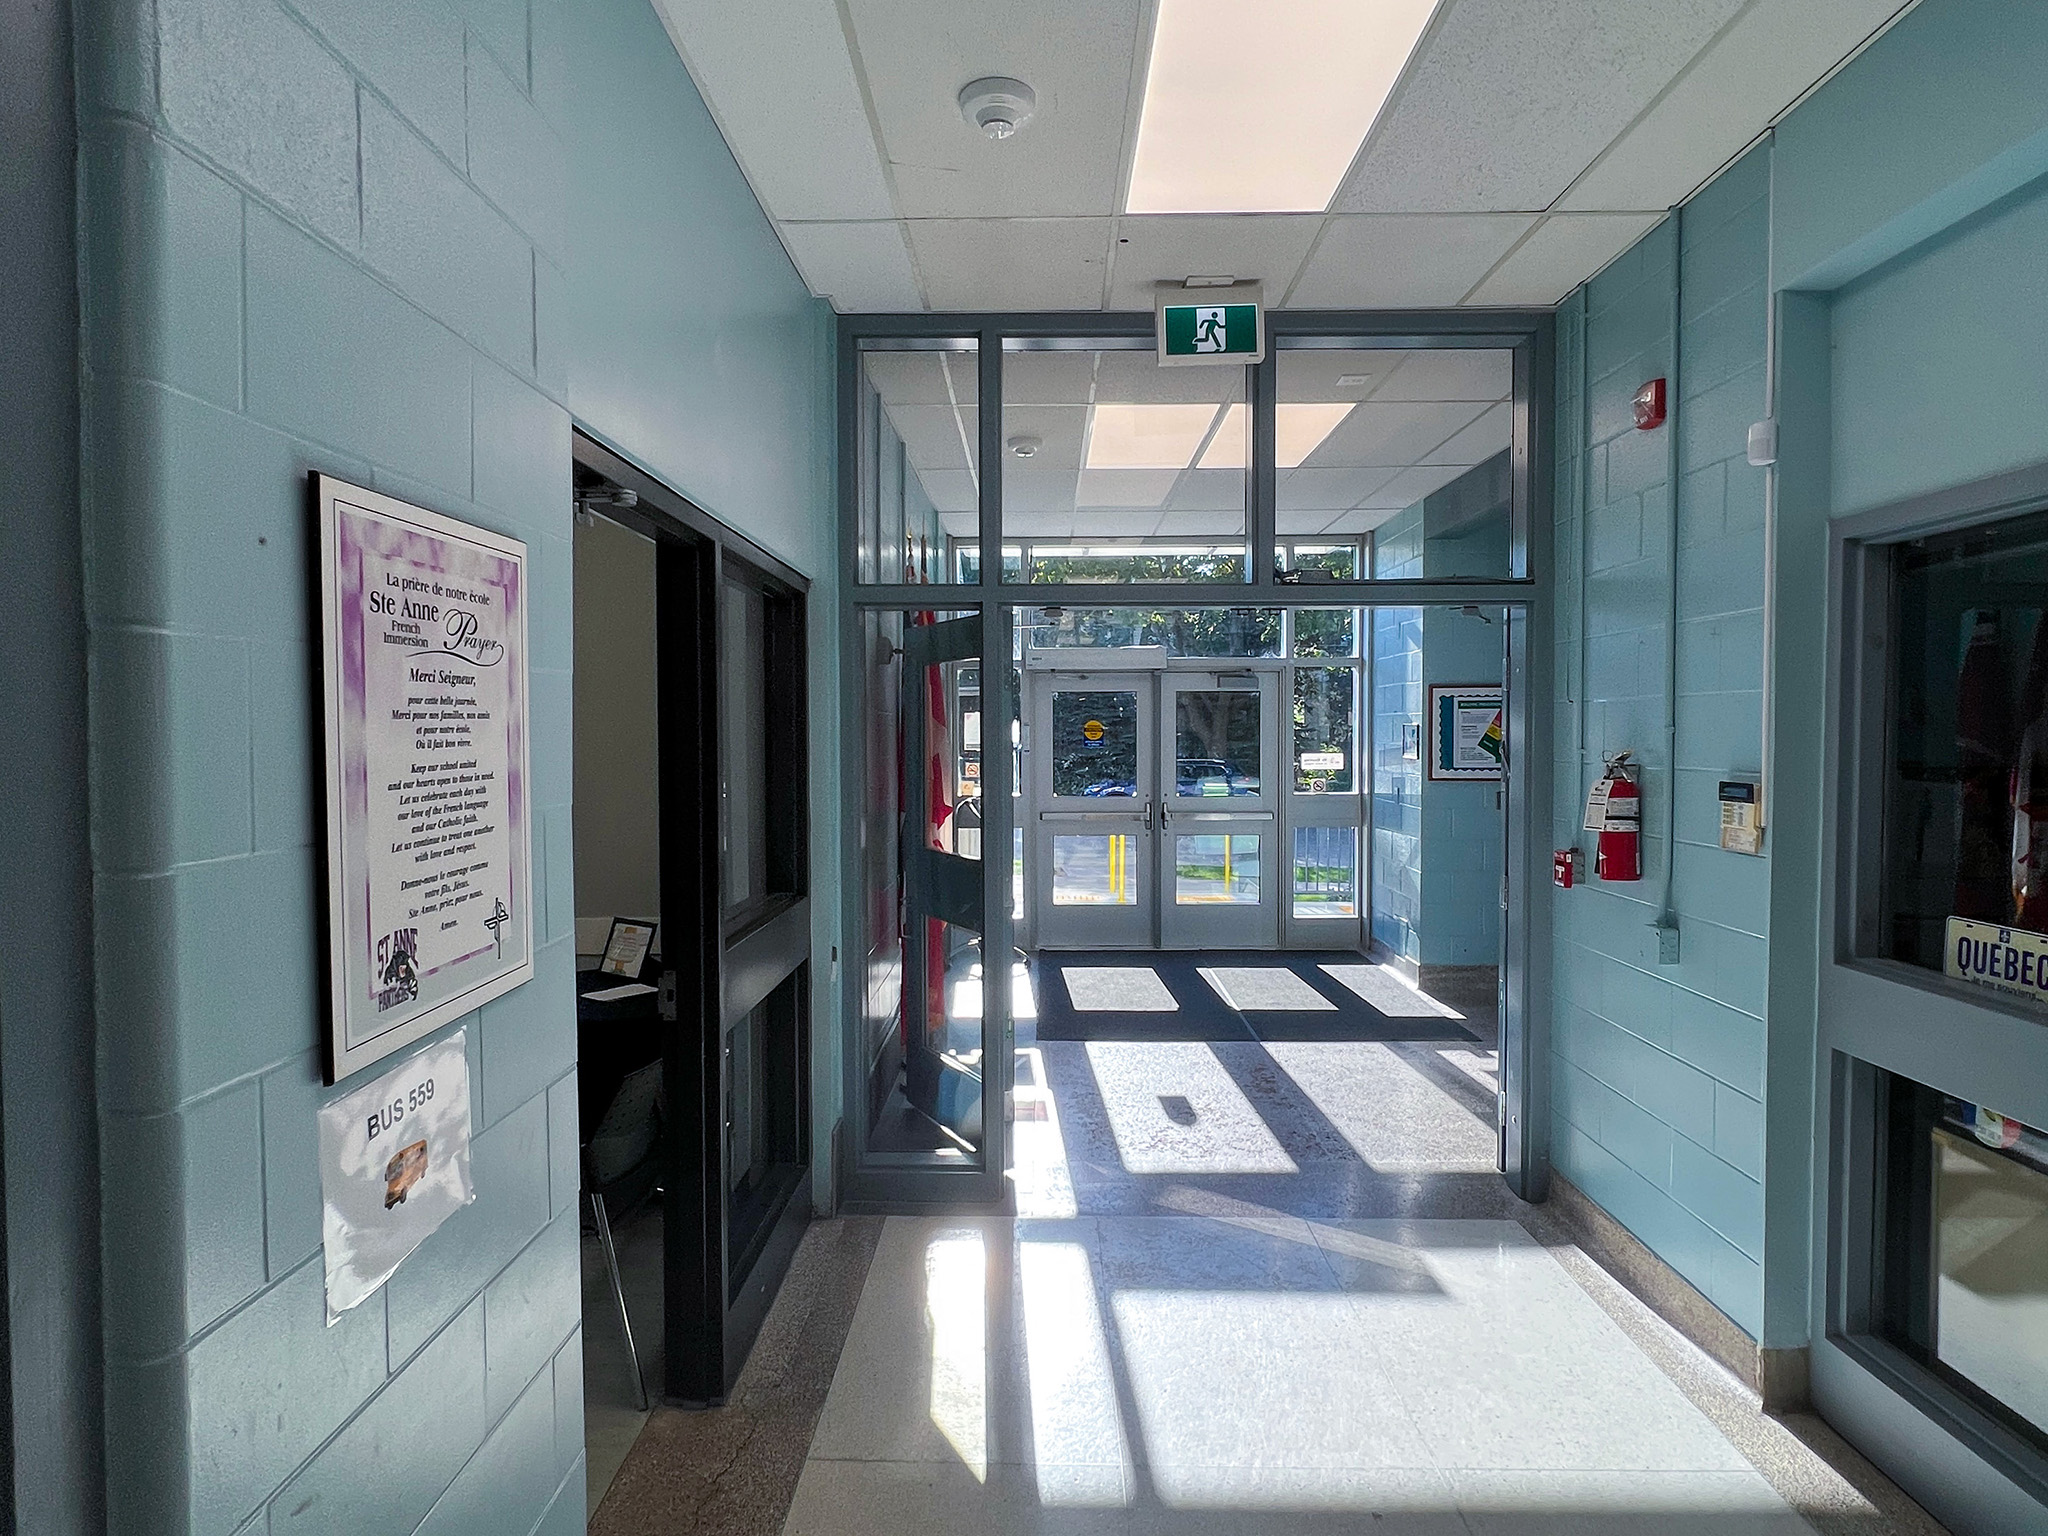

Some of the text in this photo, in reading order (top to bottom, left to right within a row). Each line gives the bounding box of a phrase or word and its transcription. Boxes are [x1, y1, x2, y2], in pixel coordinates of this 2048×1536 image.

[386, 572, 491, 606] La prière de notre école
[369, 590, 440, 623] Ste Anne
[391, 619, 421, 635] French
[383, 632, 429, 648] Immersion
[409, 667, 477, 688] Merci Seigneur,
[408, 697, 423, 707] pour
[440, 695, 453, 706] belle
[392, 709, 411, 720] Merci
[412, 712, 428, 722] pour
[477, 710, 490, 720] amis
[423, 727, 438, 737] pour
[440, 726, 455, 734] notre
[427, 740, 432, 749] il
[432, 739, 444, 751] fait
[445, 739, 456, 748] bon
[411, 759, 477, 775] Keep our school united
[388, 780, 402, 791] and
[403, 781, 415, 790] our
[416, 777, 436, 788] hearts
[436, 778, 451, 788] open
[452, 776, 458, 784] to
[459, 773, 474, 783] those
[474, 772, 480, 782] in
[400, 785, 487, 806] Let us celebrate each day with
[398, 800, 489, 820] our love of the French language
[412, 822, 424, 834] and
[426, 822, 437, 832] our
[438, 818, 463, 829] Catholic
[391, 824, 495, 854] Let us continue to treat one another
[414, 851, 428, 863] with
[430, 848, 442, 860] love
[443, 846, 455, 856] and
[440, 871, 446, 880] le
[446, 866, 469, 877] courage
[470, 862, 489, 872] comme
[408, 908, 419, 919] Ste
[454, 894, 468, 906] pour
[378, 934, 390, 979] ST
[1958, 936, 2048, 991] QUEBEC
[366, 1078, 436, 1142] BUS 559
